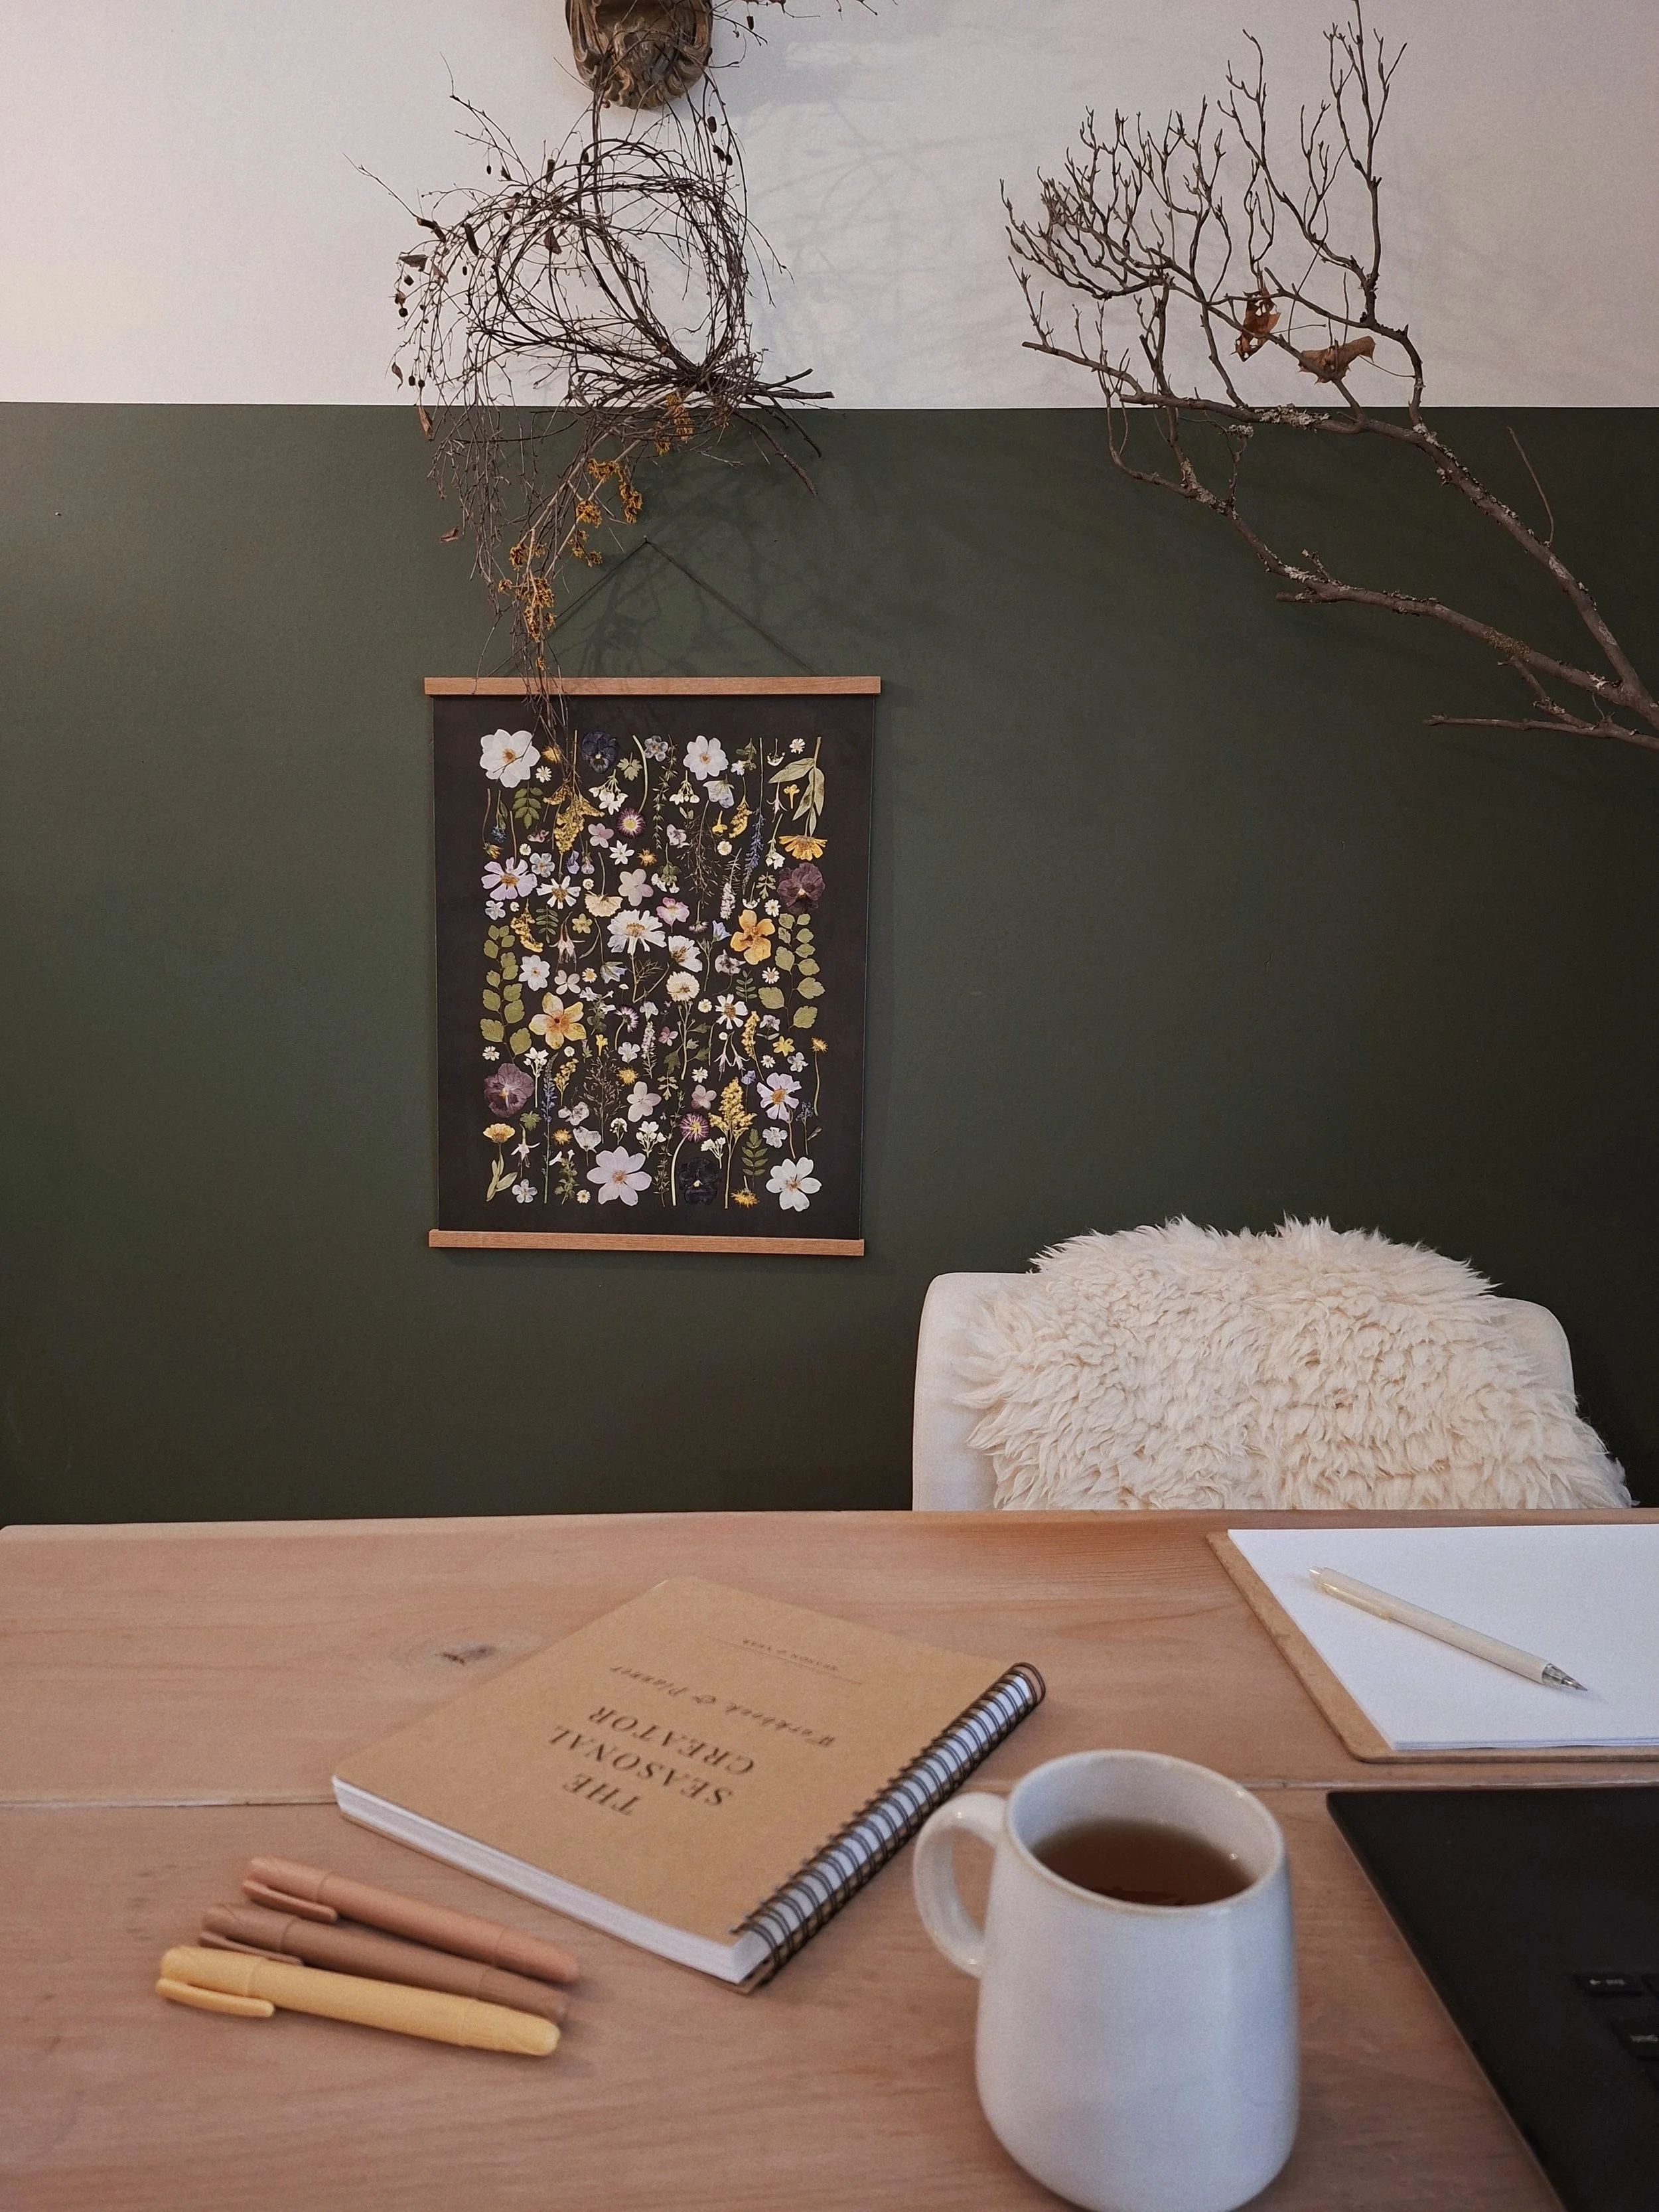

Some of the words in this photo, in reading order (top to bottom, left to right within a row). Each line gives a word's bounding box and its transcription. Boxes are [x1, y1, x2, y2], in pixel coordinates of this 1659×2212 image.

[609, 1665, 689, 1697] Planner
[693, 1694, 717, 1704] &
[588, 1706, 755, 1775] CREATOR
[725, 1702, 835, 1747] Workbook
[548, 1726, 733, 1807] SEASONAL
[561, 1773, 641, 1816] THE
